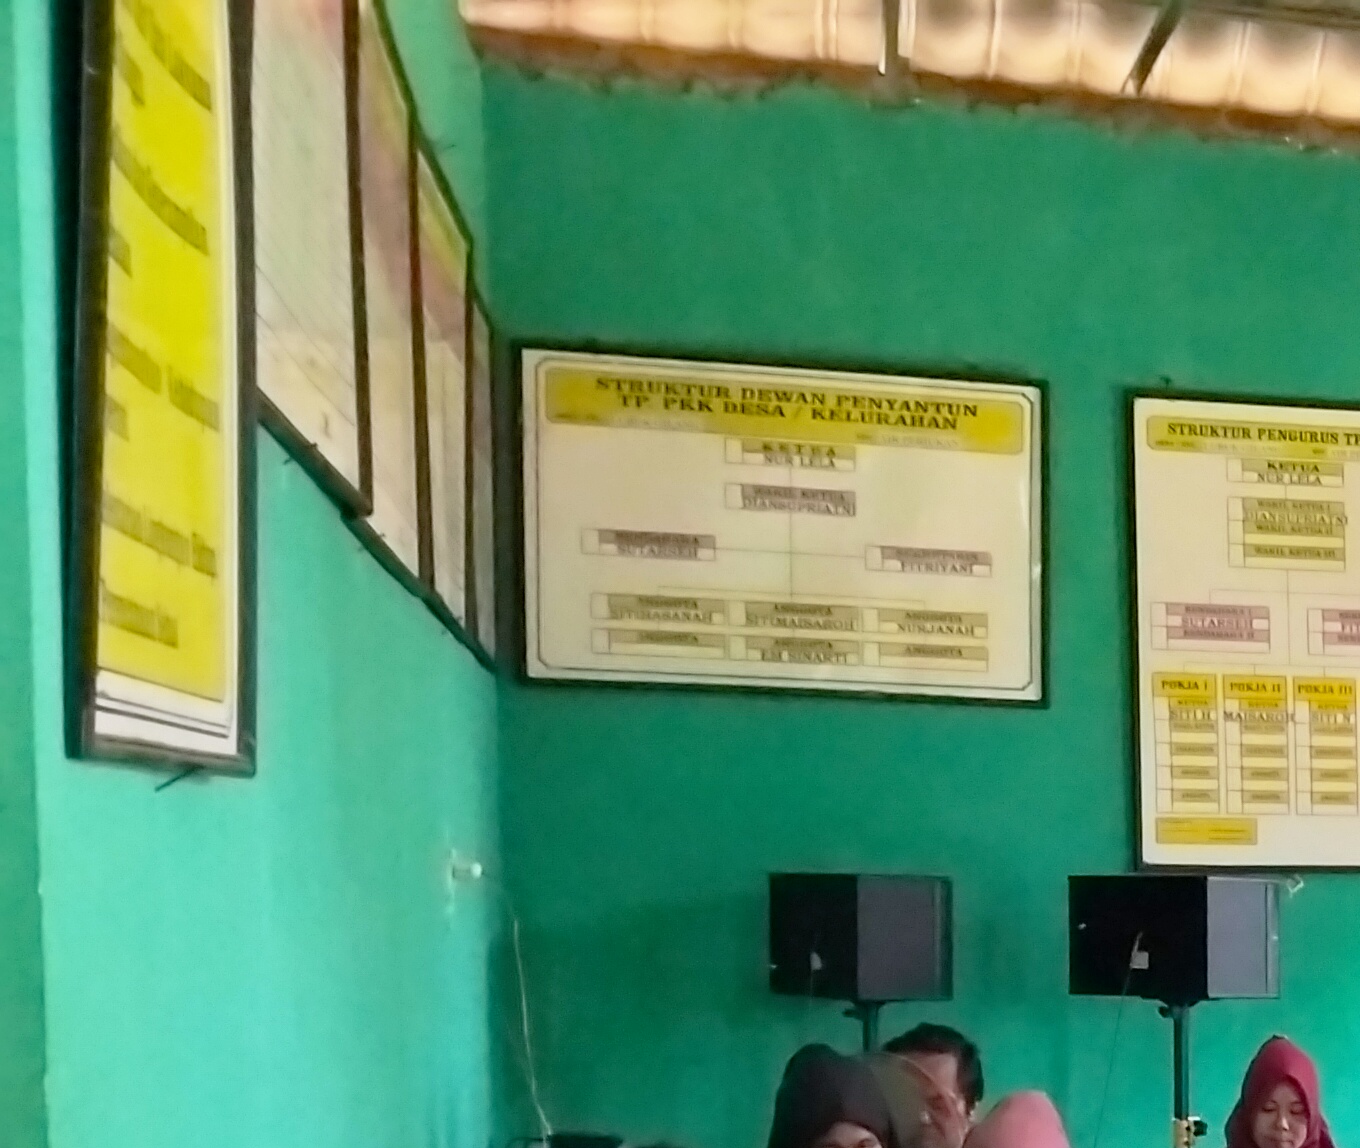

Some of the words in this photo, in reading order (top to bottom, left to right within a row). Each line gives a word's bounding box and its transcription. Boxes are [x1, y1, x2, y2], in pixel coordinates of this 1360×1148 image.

[597, 377, 731, 400] STRUKTUR
[741, 387, 826, 406] DEWAN
[836, 395, 978, 418] PENYANTUN
[621, 395, 650, 408] TP
[723, 401, 786, 418] DESA
[811, 407, 958, 430] KELURAHAN
[1167, 423, 1252, 440] STRUKTUR
[1257, 428, 1339, 445] PENGURUS
